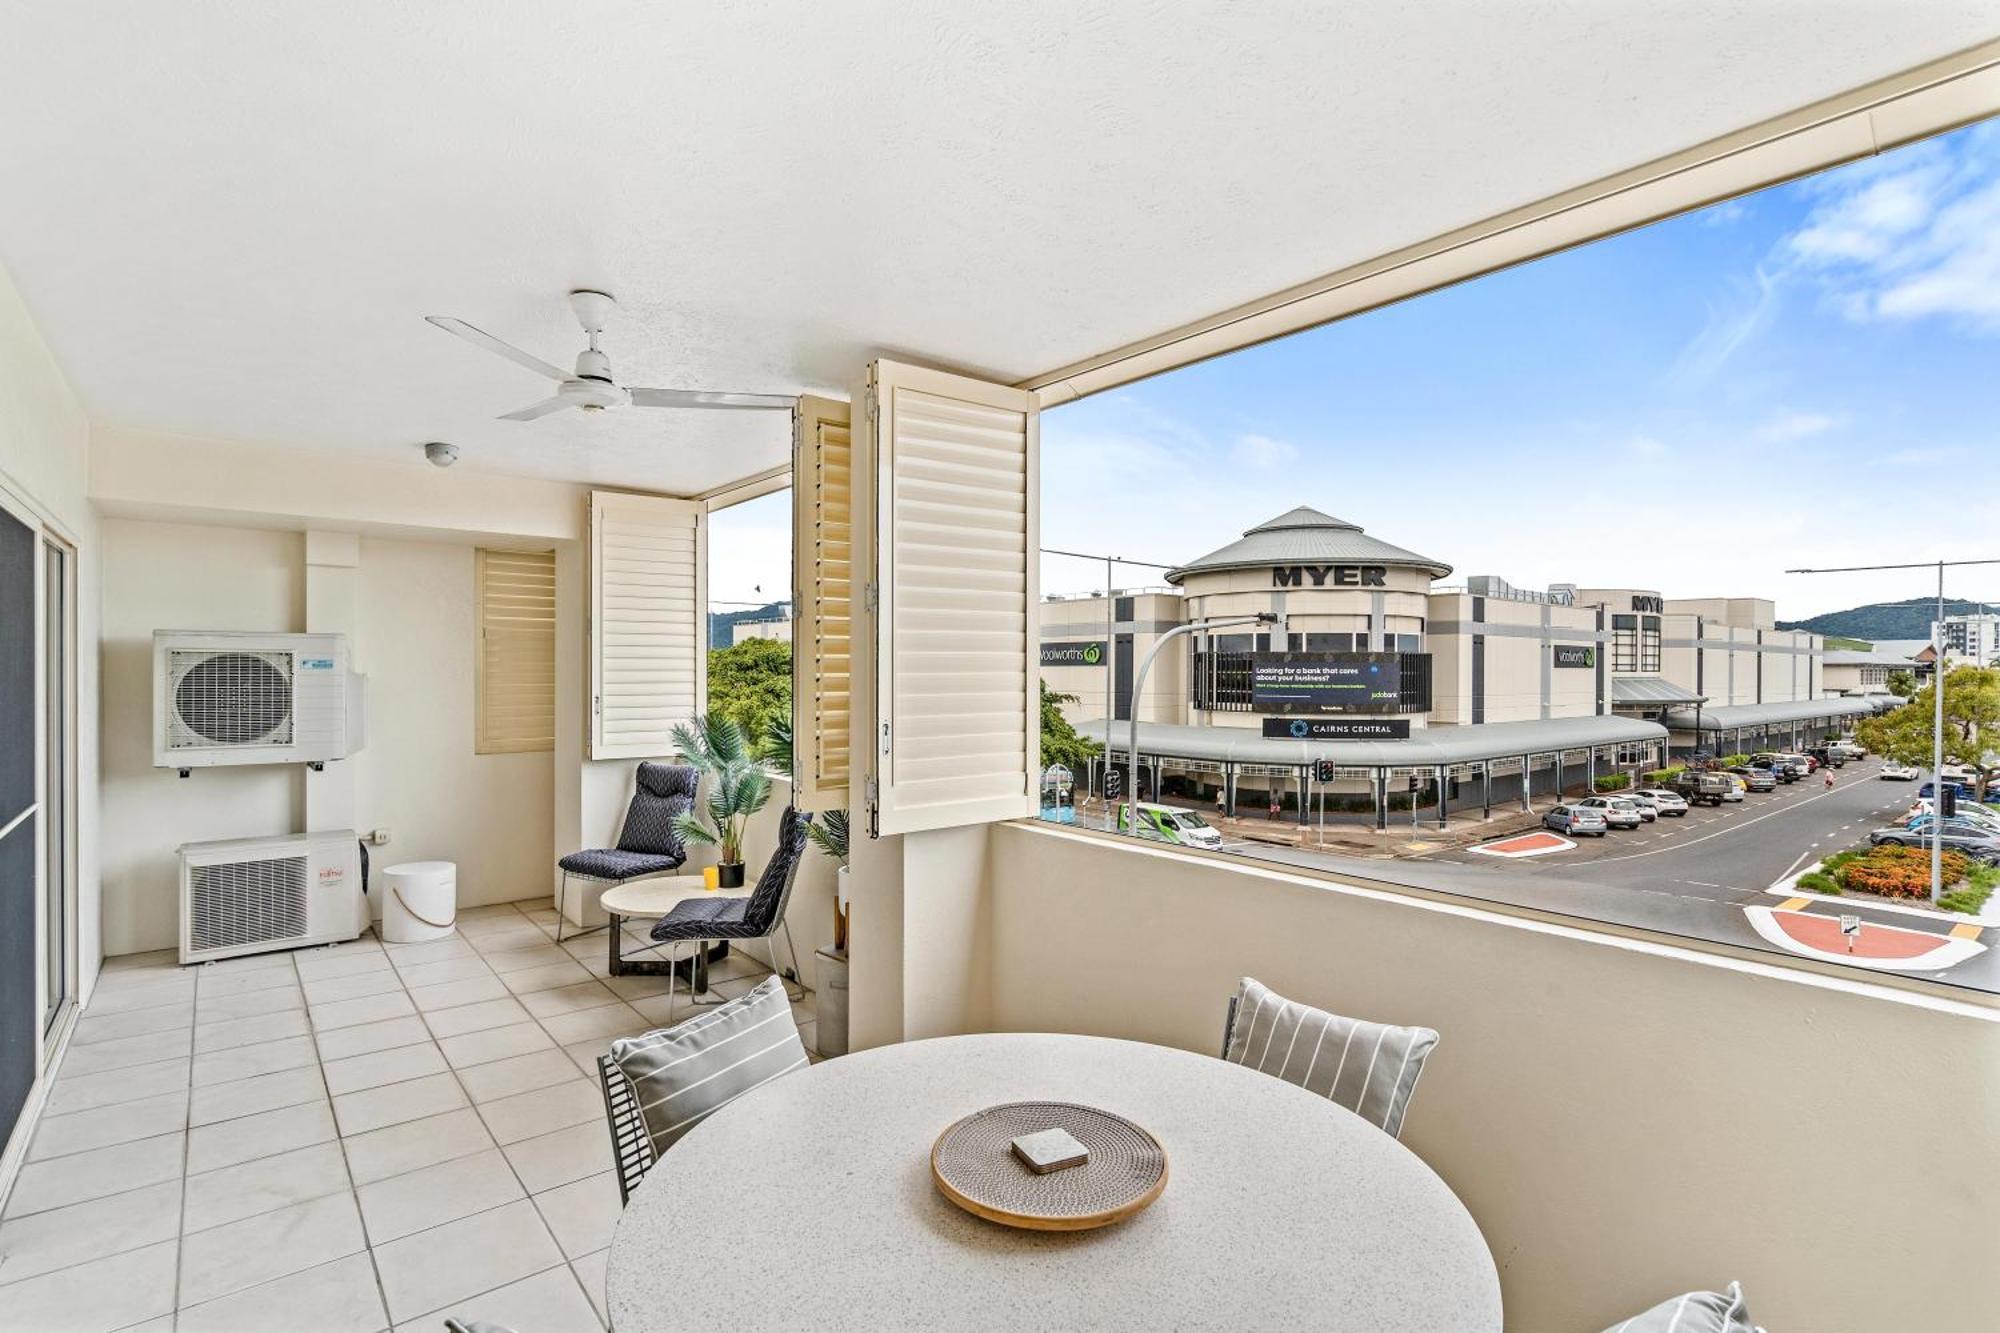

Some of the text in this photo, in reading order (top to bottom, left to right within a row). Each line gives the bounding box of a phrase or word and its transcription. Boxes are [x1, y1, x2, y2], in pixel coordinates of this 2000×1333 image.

[1273, 566, 1386, 587] MYER
[1256, 667, 1283, 675] Looking
[1294, 674, 1330, 682] business?
[1313, 725, 1392, 733] CAIRNS CENTRAL
